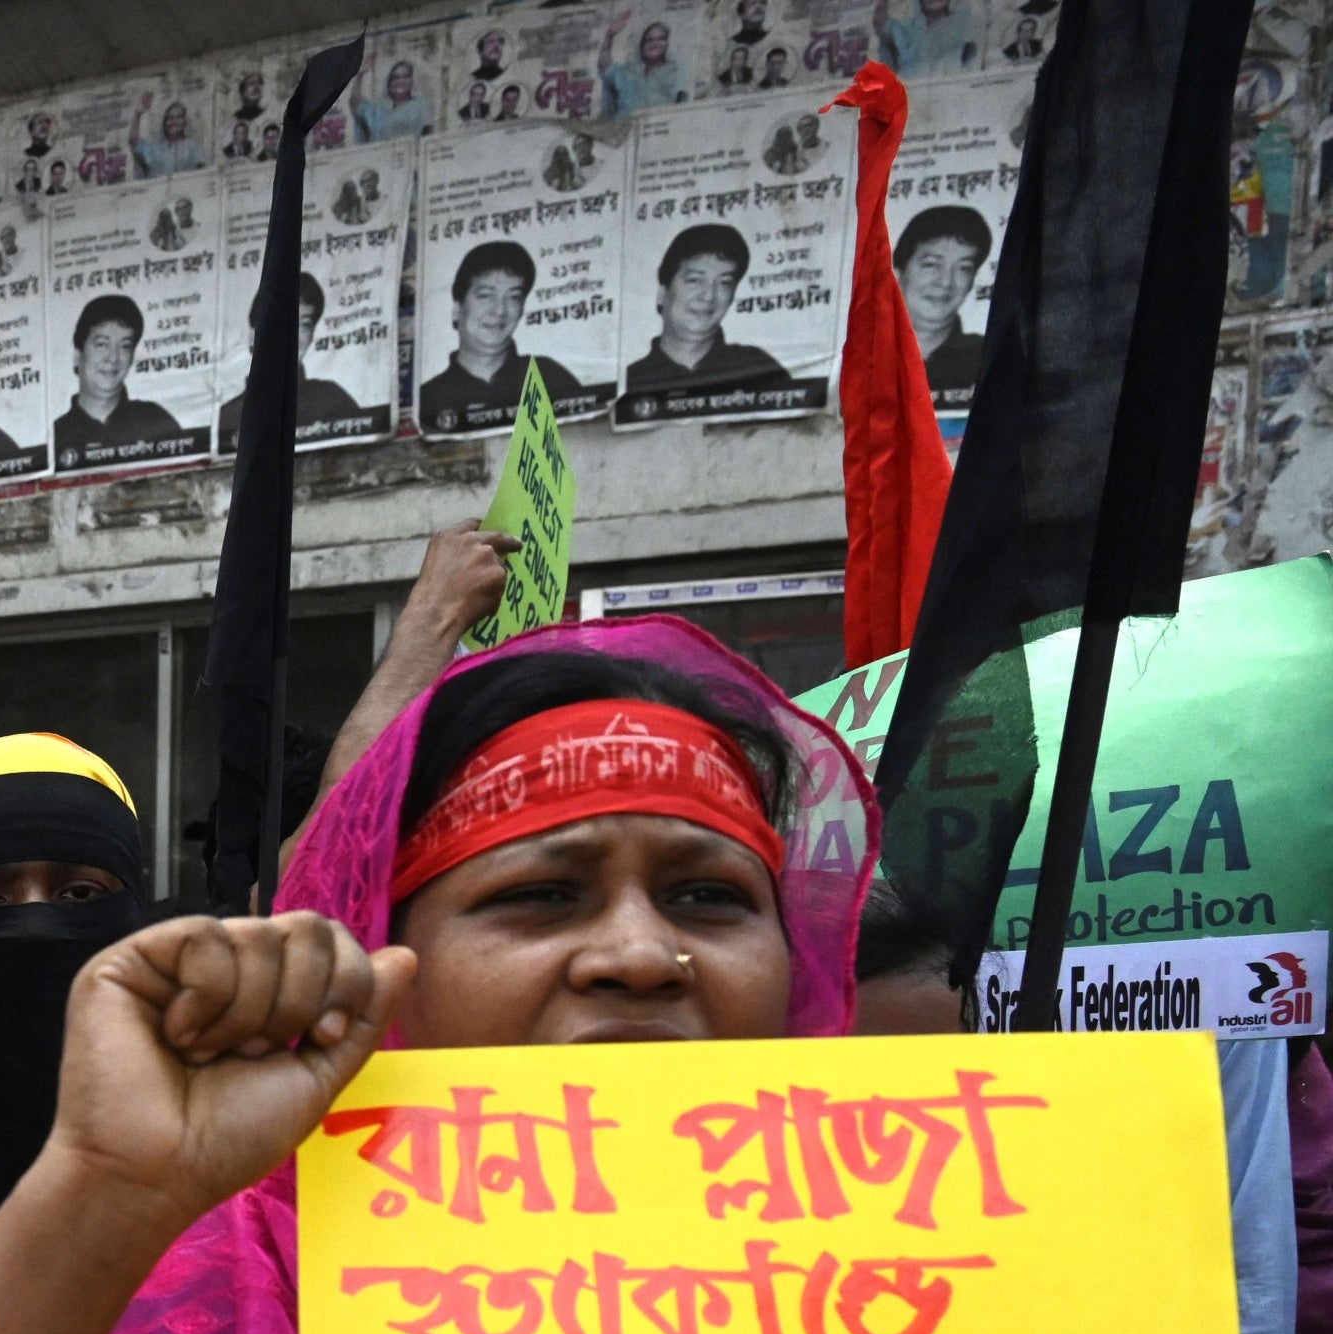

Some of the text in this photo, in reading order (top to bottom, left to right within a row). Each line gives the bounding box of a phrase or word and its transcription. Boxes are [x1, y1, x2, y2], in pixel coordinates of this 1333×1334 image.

[523, 372, 541, 432] WE
[521, 518, 561, 621] PENALTY
[1007, 888, 1276, 951] potection
[1071, 961, 1200, 1031] Federation
[324, 1071, 1049, 1229] রানা প্লাজা
